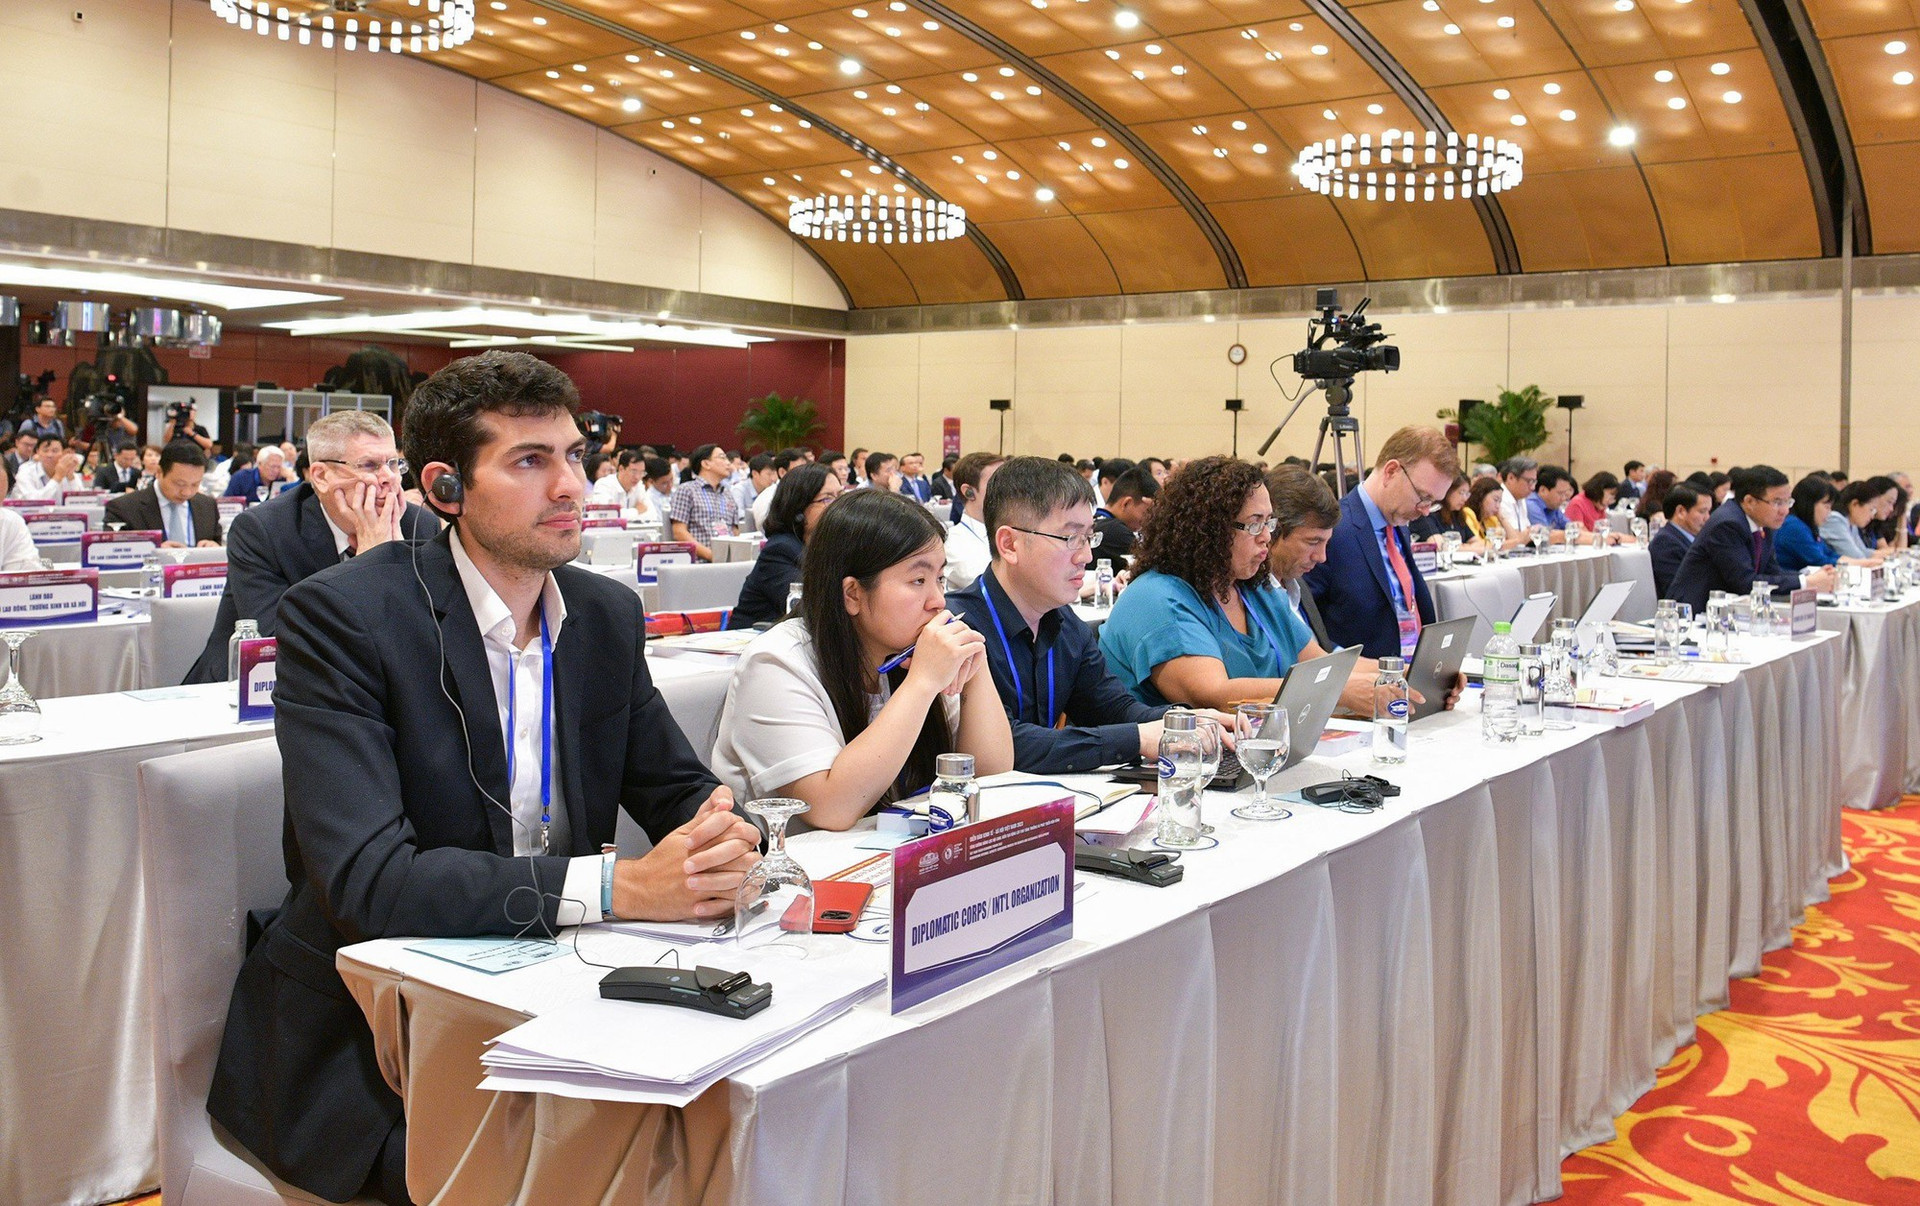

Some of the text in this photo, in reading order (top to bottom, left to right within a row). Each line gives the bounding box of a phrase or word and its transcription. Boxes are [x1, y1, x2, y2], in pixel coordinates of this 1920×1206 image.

[254, 681, 276, 692] DIPLO
[911, 910, 959, 946] DIPLOMATIC
[1011, 874, 1060, 908] ORGANIZATION
